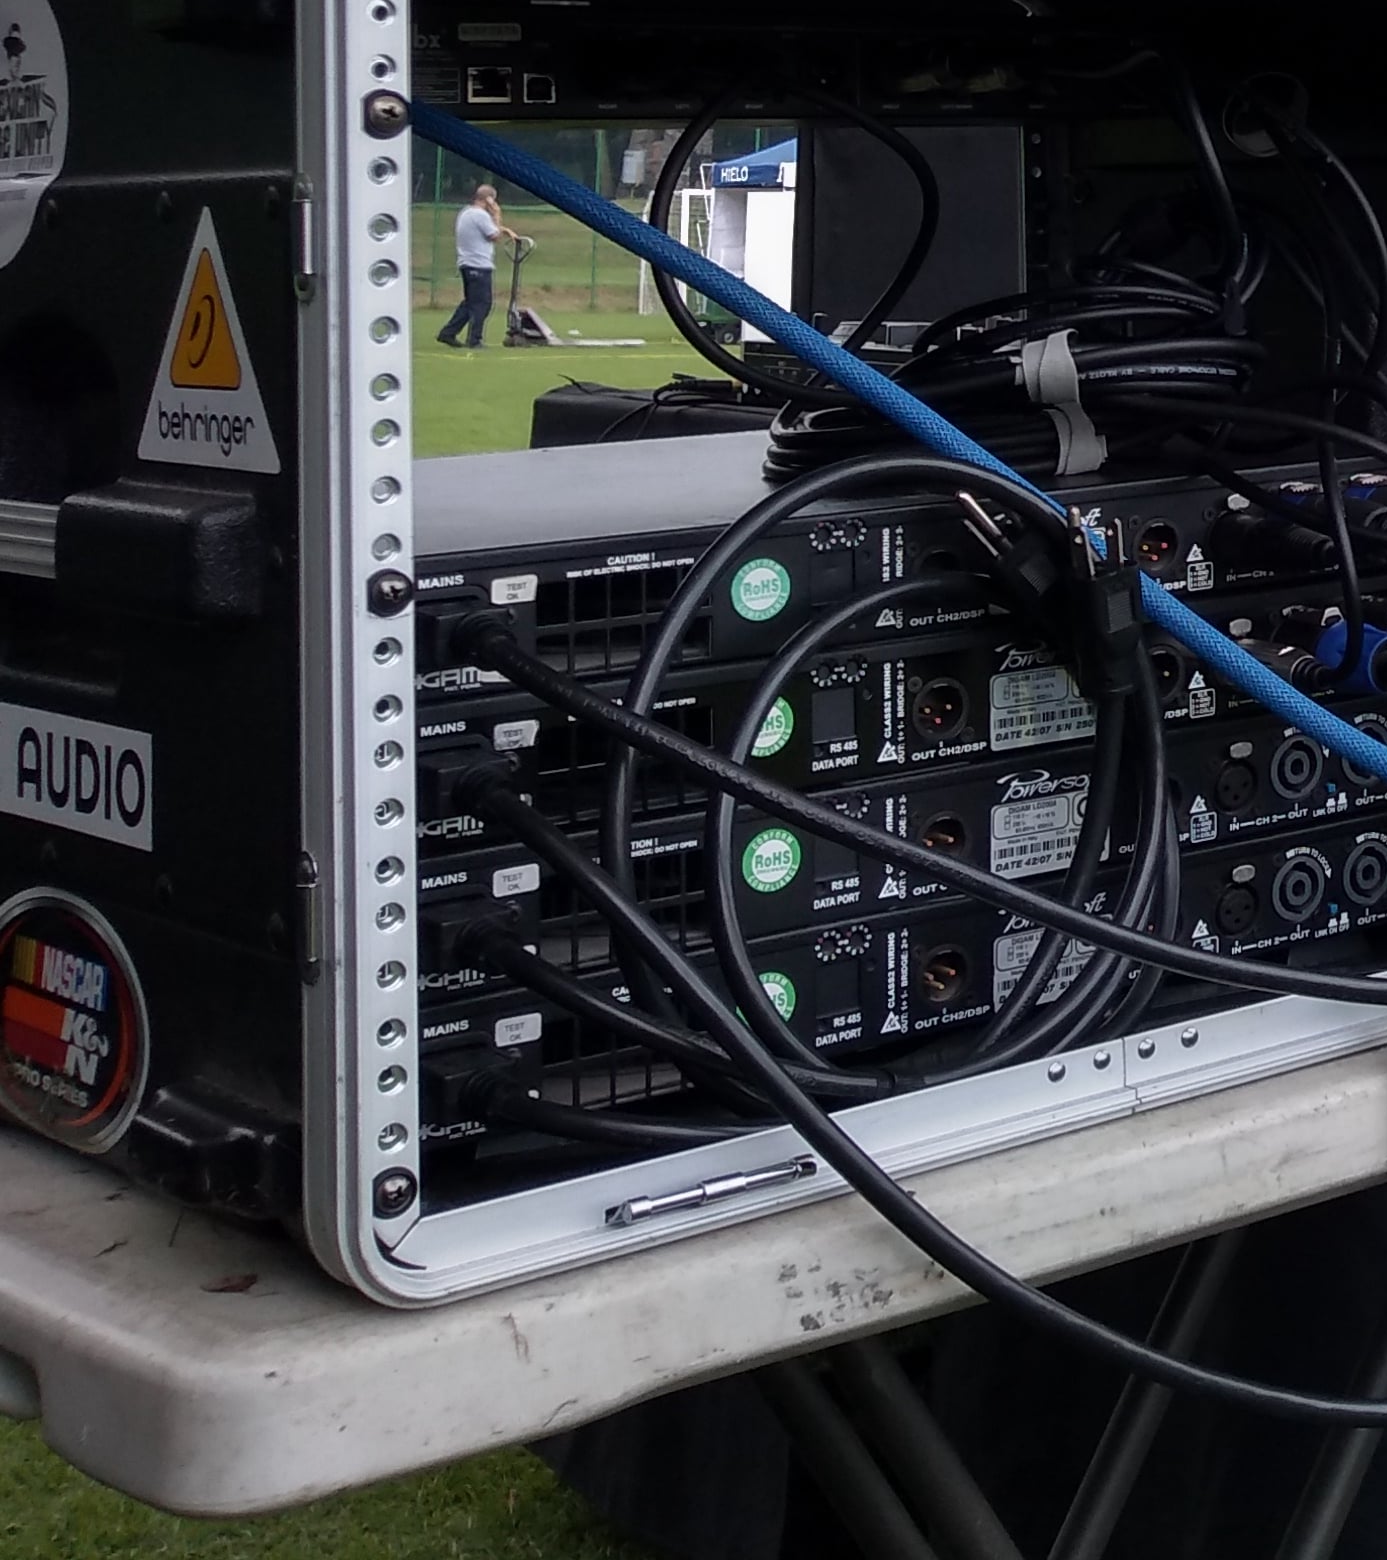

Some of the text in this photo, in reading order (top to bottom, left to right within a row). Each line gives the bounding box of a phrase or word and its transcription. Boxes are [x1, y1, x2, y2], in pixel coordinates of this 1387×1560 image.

[412, 24, 441, 48] bx
[720, 165, 749, 183] HIELO
[158, 400, 256, 457] behringer
[882, 527, 890, 564] WIRING
[607, 554, 648, 566] CAUTION
[895, 547, 903, 578] RIDGE:
[418, 575, 465, 590] MAINS
[506, 581, 527, 591] TEST
[743, 581, 779, 597] RoHS
[1160, 580, 1187, 591] /DSP
[506, 592, 519, 600] OK
[909, 609, 985, 627] OUT CH2/DSP
[883, 662, 892, 700] WIRING
[420, 721, 466, 737] MAINS
[503, 729, 523, 738] TEST
[994, 729, 1022, 742] DATE
[829, 740, 859, 753] RS 485
[911, 741, 987, 762] OUT CH2/DSP
[812, 755, 860, 772] DATA PORT
[17, 726, 146, 828] AUDIO
[996, 769, 1091, 802] Powerso
[1355, 795, 1375, 806] OUT
[1229, 822, 1240, 832] IN
[1255, 816, 1271, 826] CH
[1288, 808, 1309, 820] OUT
[630, 838, 653, 851] TION
[750, 828, 794, 849] CONFORM
[1119, 844, 1135, 854] OU
[754, 850, 791, 869] RoHS
[994, 859, 1022, 873] DATE
[422, 872, 468, 890] MAINS
[503, 872, 524, 883] TEST
[748, 864, 799, 892] COMPLIANCE
[831, 877, 860, 891] RS 485
[508, 883, 520, 891] OK
[912, 883, 936, 896] OUT
[813, 892, 860, 910] DATA PORT
[1357, 914, 1377, 925] OUT
[1231, 945, 1242, 955] IN
[1257, 938, 1273, 949] CH
[1289, 929, 1311, 941] OUT
[41, 944, 106, 1012] NASCAR
[887, 932, 896, 1009] CLASS2 WIRING
[900, 951, 909, 988] BRIDGE:
[833, 1012, 862, 1027] RS 485
[914, 1005, 991, 1030] OUT CH2/DSP
[423, 1020, 469, 1038] MAINS
[504, 1022, 525, 1032] TEST
[509, 1032, 522, 1041] OK
[815, 1028, 863, 1047] DATA PORT
